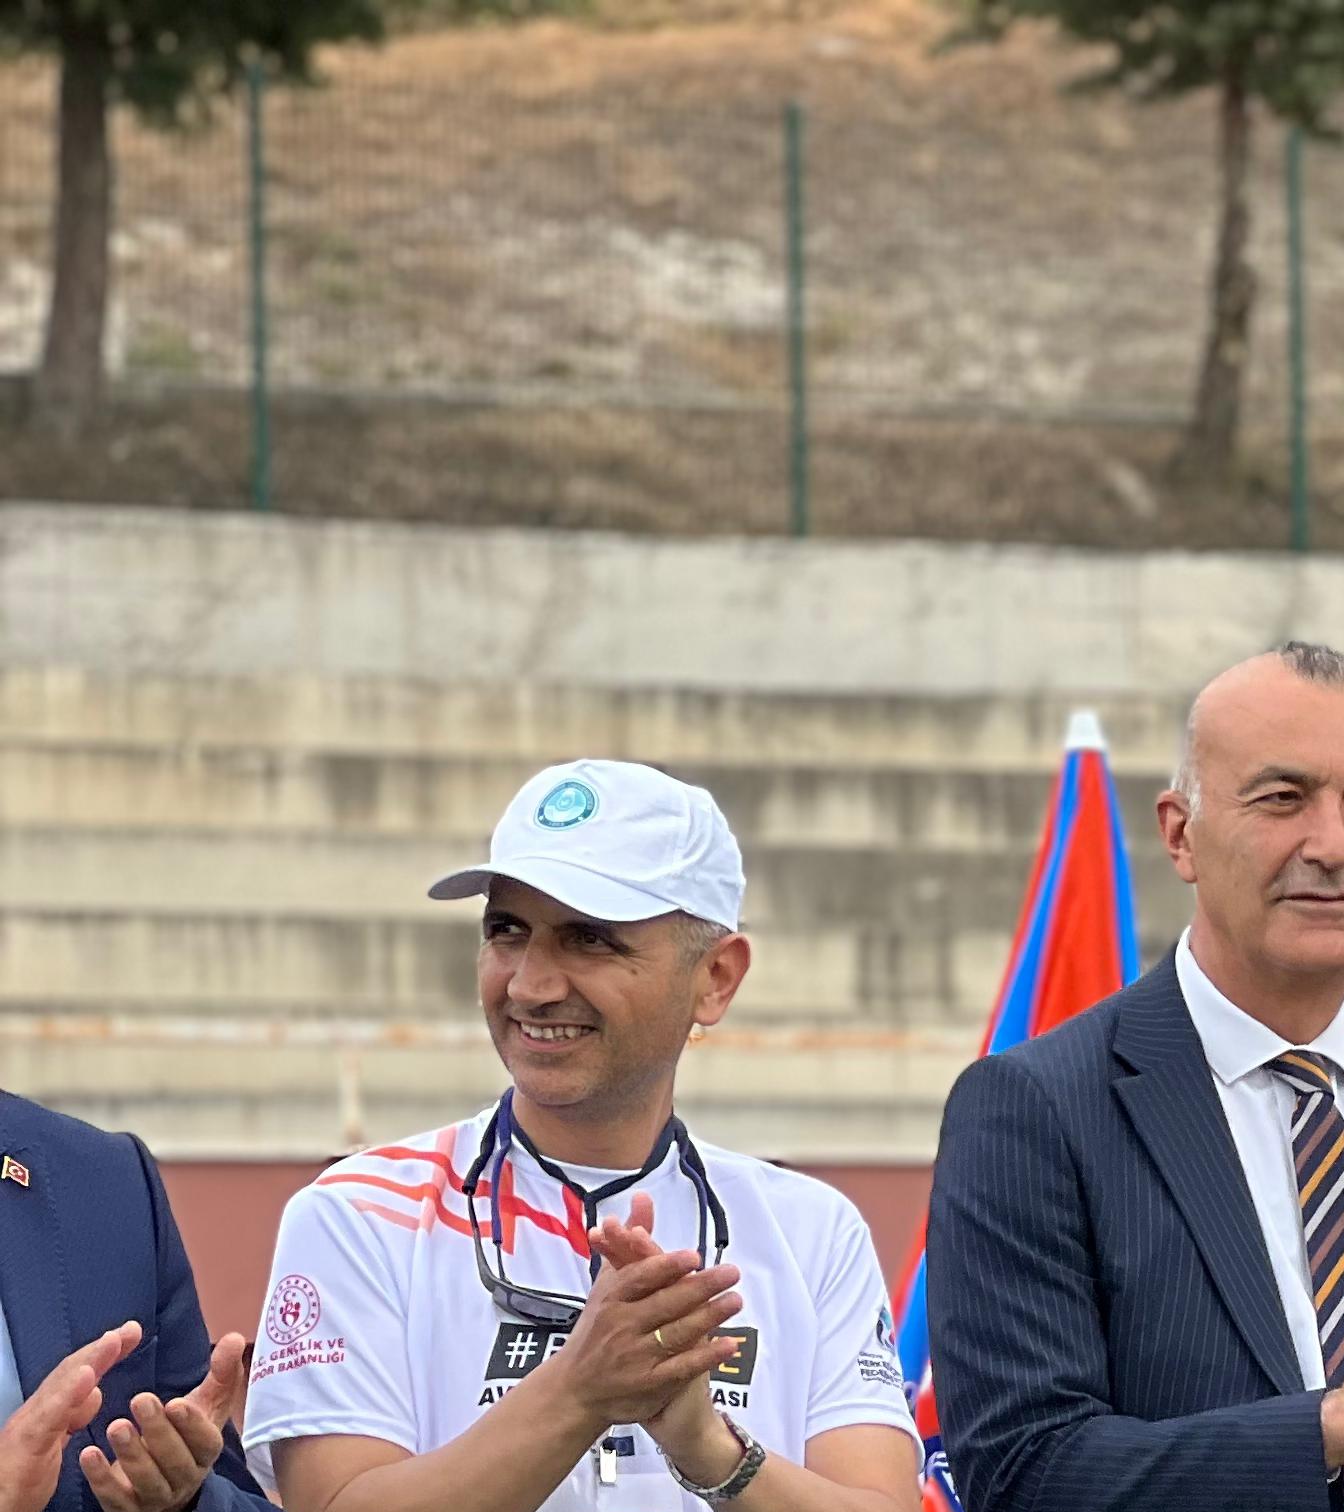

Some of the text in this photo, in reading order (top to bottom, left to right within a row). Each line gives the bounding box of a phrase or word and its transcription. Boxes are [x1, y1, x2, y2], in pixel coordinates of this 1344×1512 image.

[270, 1339, 322, 1362] GENÇLİK
[327, 1337, 345, 1349] VE
[278, 1351, 345, 1372] BAKANLIĞI
